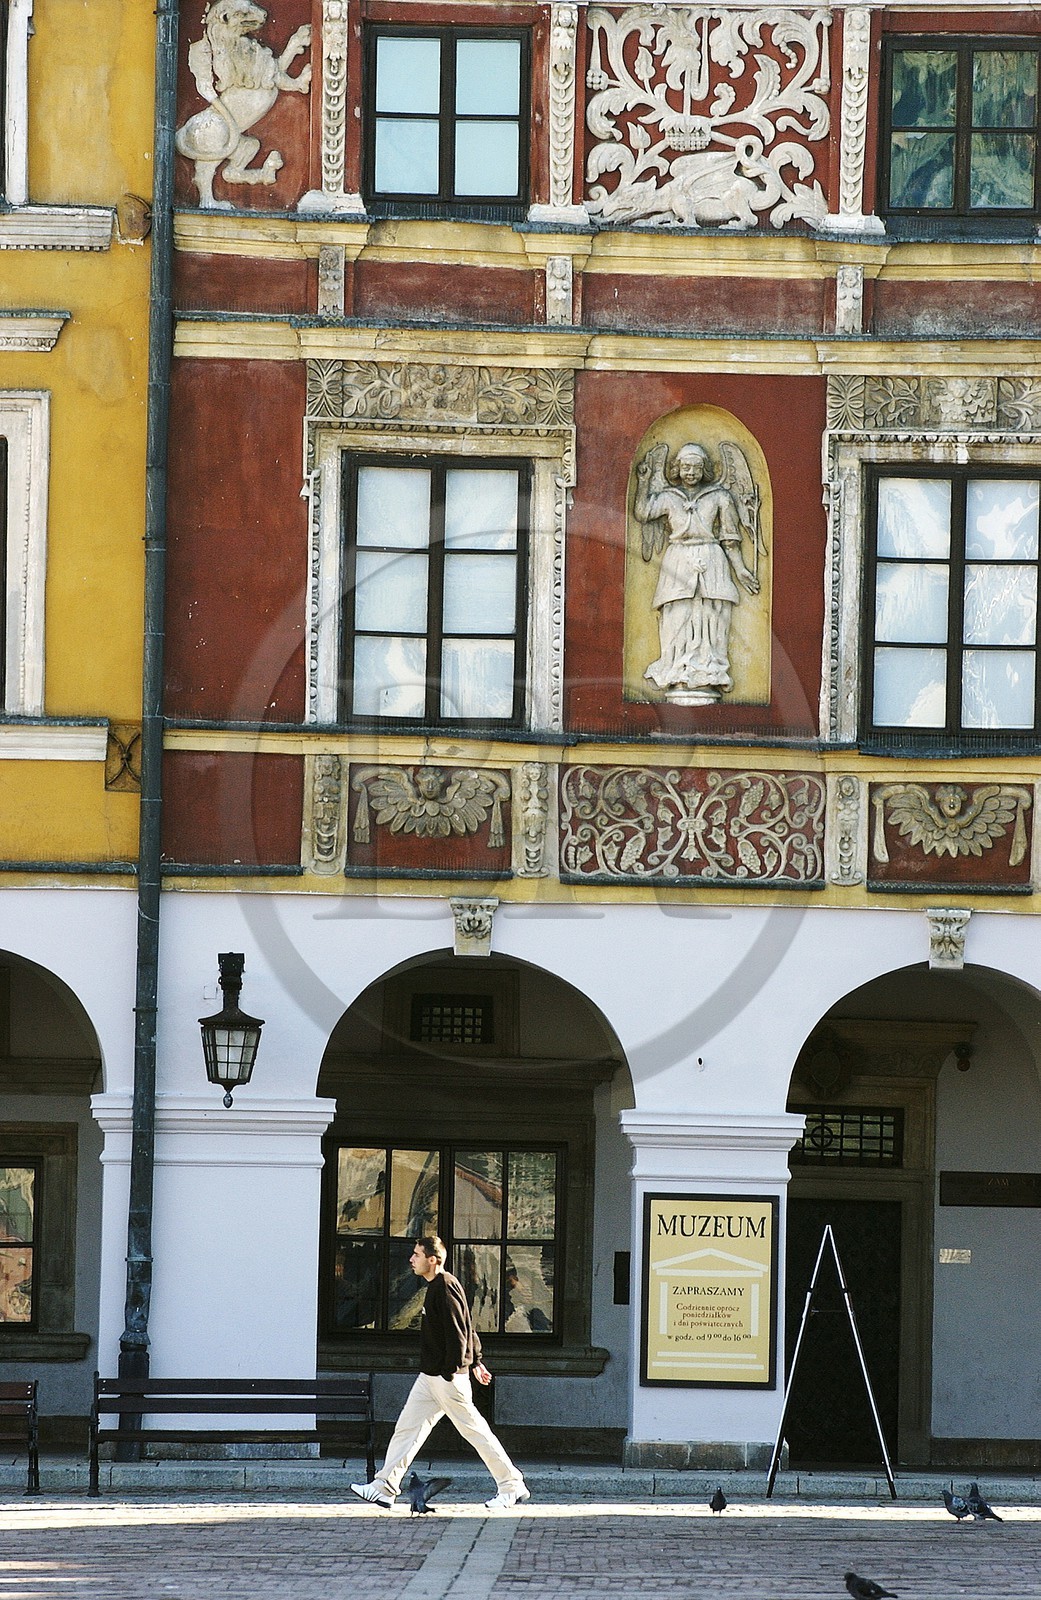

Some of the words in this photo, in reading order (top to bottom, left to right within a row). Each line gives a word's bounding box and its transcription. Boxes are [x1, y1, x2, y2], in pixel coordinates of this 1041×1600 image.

[657, 1214, 766, 1238] MUZEUM
[672, 1286, 745, 1297] ZAPRASZAMY
[676, 1303, 715, 1311] Codziennie
[716, 1305, 740, 1313] oprócz
[682, 1311, 732, 1320] poniedziałków
[674, 1333, 694, 1342] godz.
[696, 1333, 706, 1341] od
